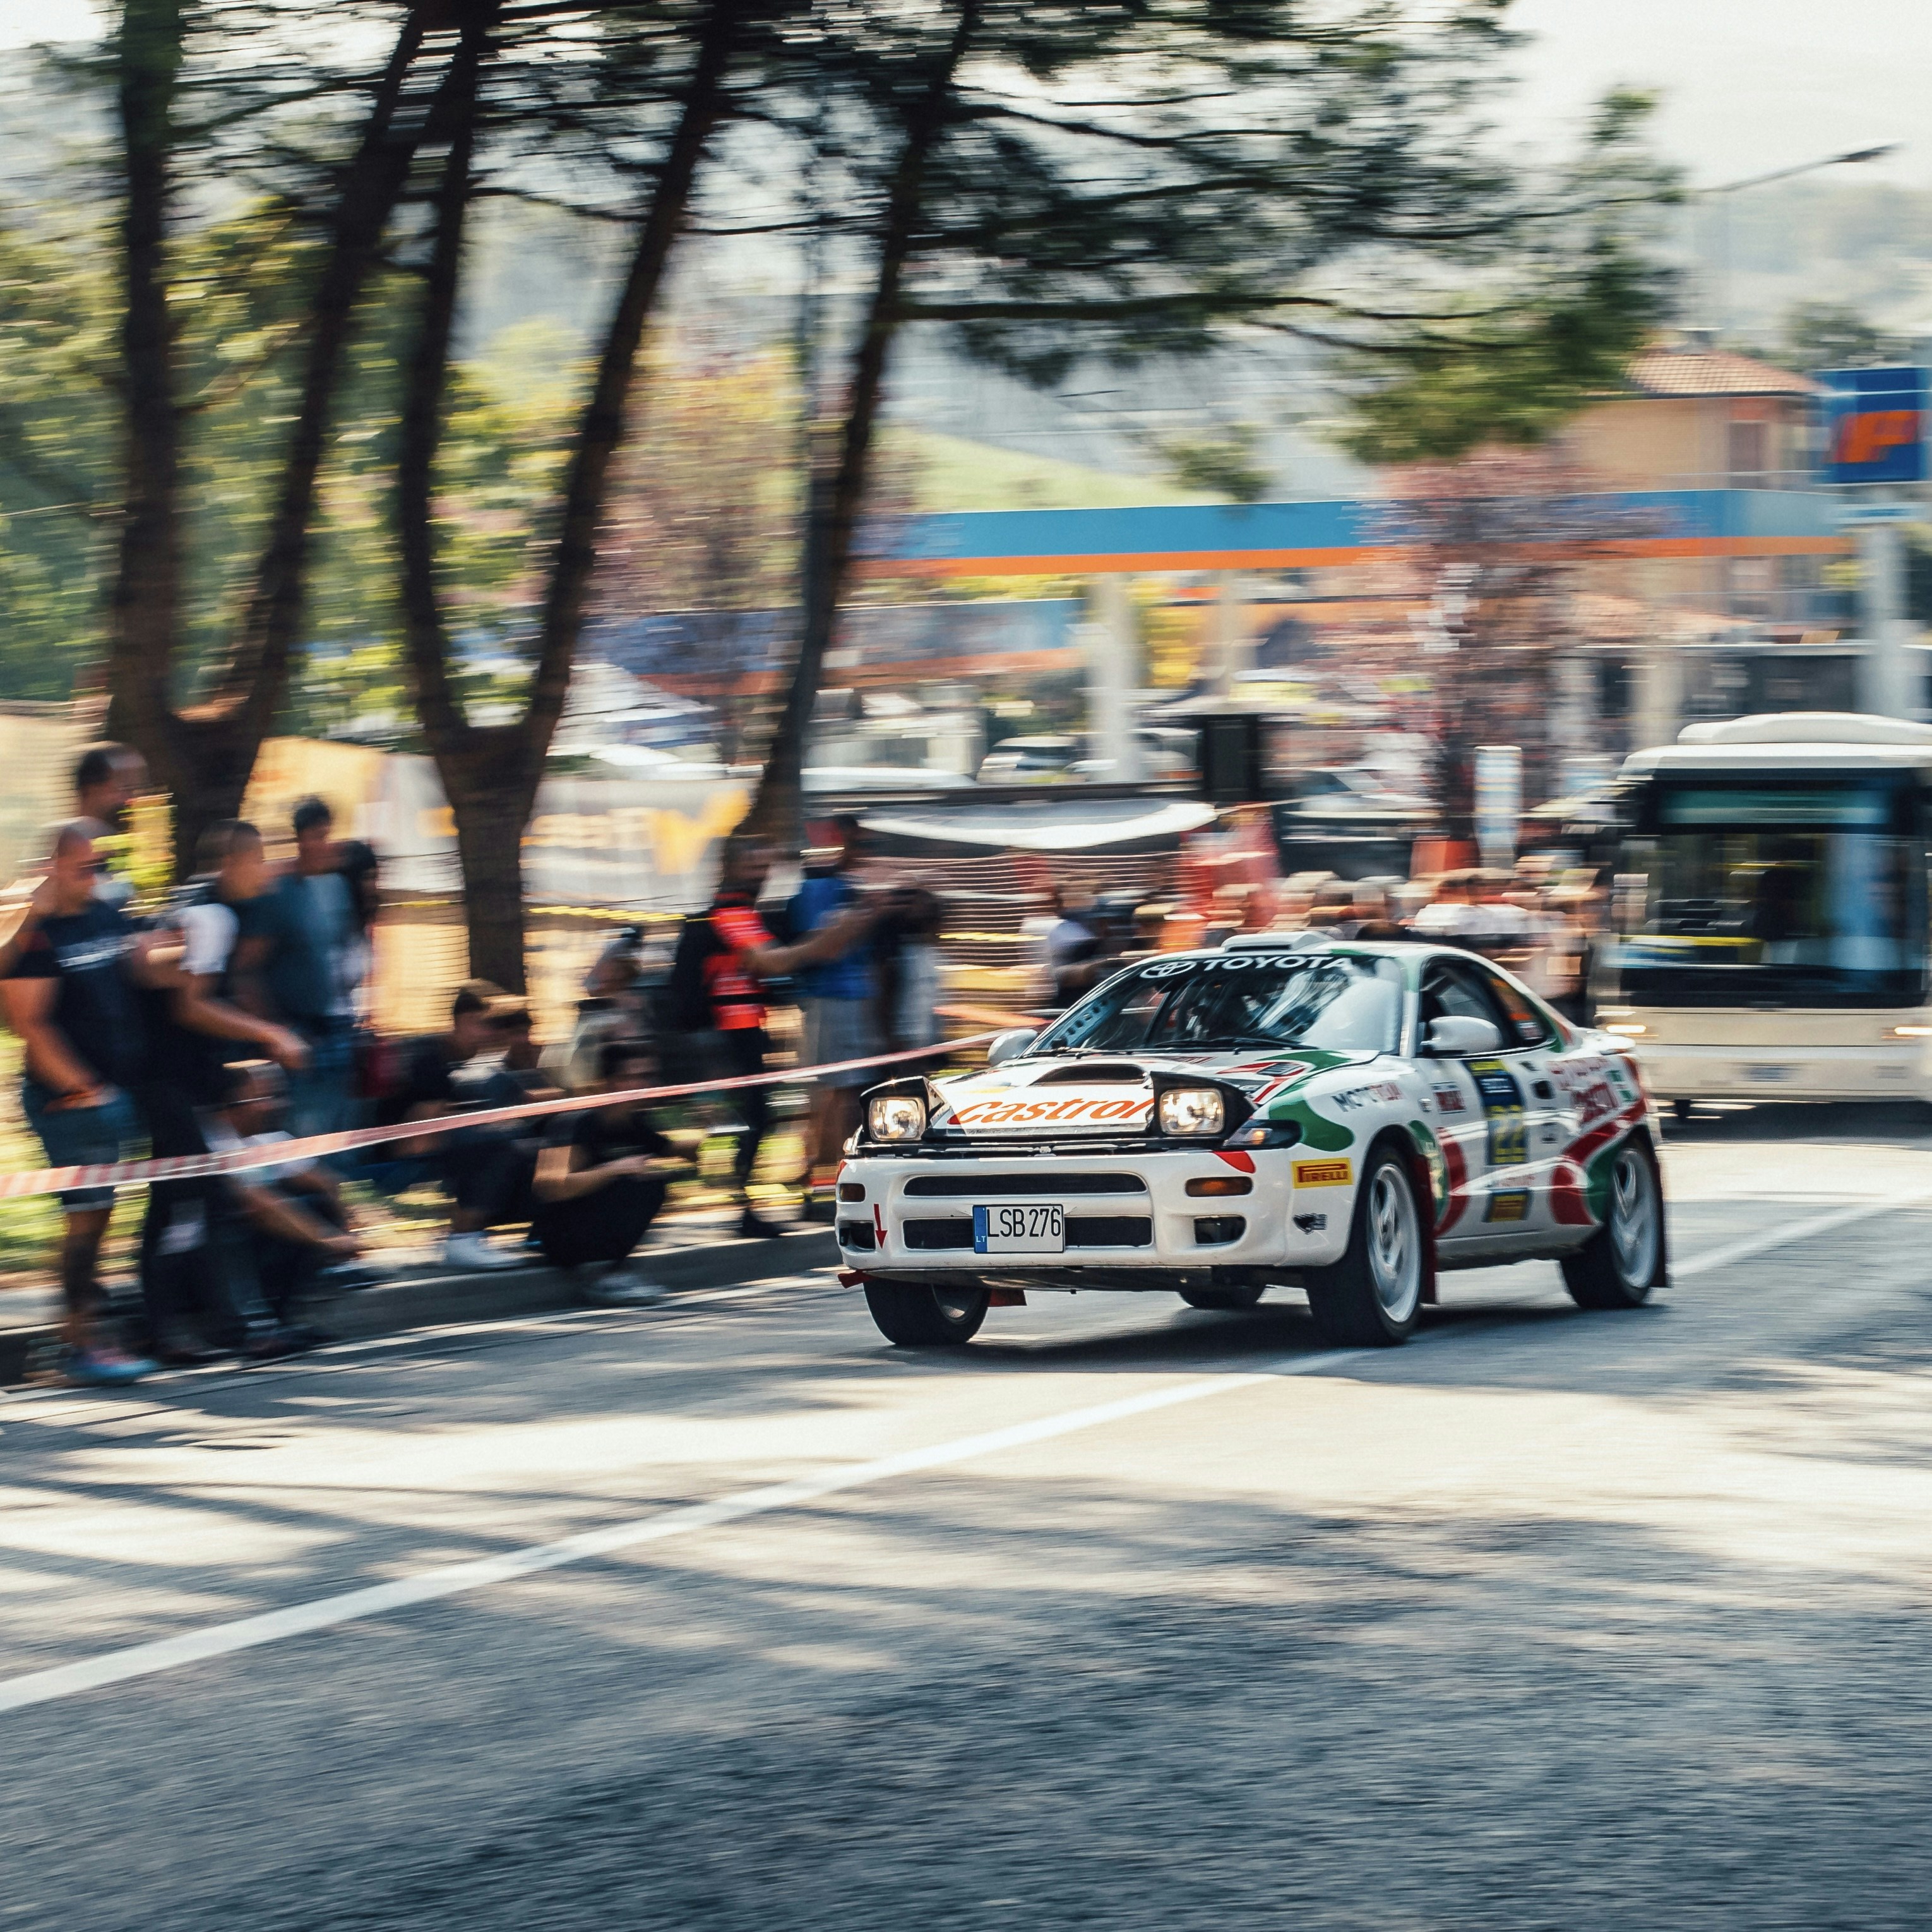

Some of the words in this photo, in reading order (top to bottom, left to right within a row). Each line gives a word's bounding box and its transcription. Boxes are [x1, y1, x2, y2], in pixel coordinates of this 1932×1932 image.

[1203, 956, 1354, 971] TOYOTA
[987, 1208, 1025, 1237] LSB
[1029, 1208, 1061, 1237] 276
